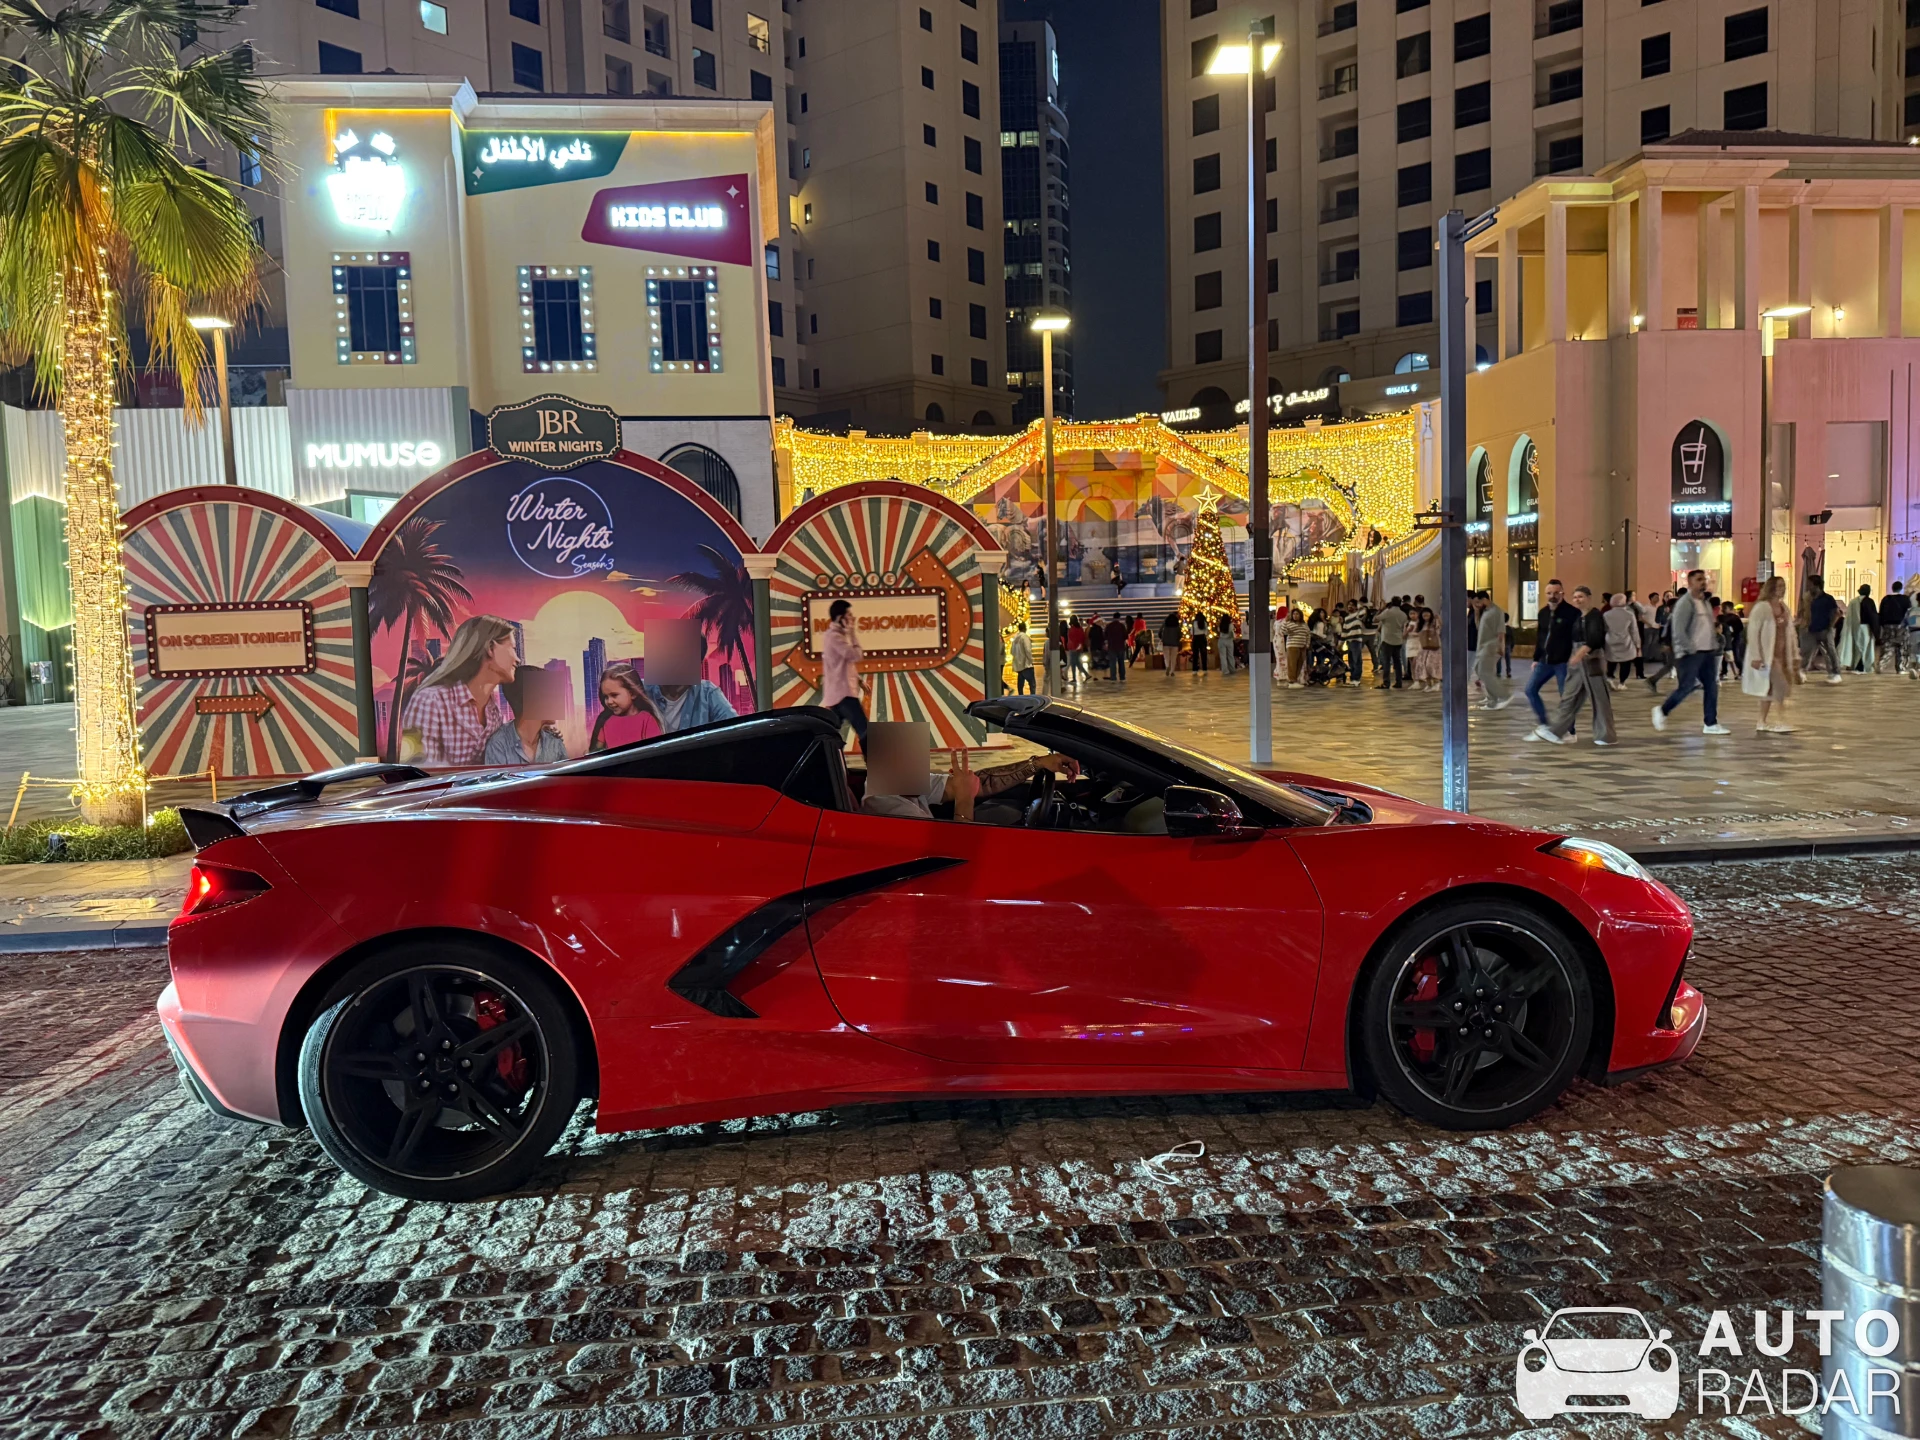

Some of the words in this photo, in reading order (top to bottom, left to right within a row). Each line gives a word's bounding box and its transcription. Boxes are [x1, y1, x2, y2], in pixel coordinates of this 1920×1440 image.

[481, 135, 546, 163] الأطفال
[549, 137, 592, 170] نادي
[611, 206, 666, 228] KIDS
[668, 206, 723, 228] CLUB
[536, 409, 583, 441] JBR
[1161, 407, 1201, 423] VAULTS
[307, 441, 441, 468] MUMUSO
[508, 441, 557, 453] WINTER
[559, 440, 603, 452] NIGHTS
[1681, 486, 1707, 495] JUICES
[506, 492, 588, 522] Winter
[527, 521, 614, 564] Nights
[571, 554, 607, 574] Season
[606, 558, 615, 570] 3
[818, 573, 894, 586] MOVIE
[857, 613, 937, 632] SHOWING
[158, 635, 182, 648] ON
[183, 632, 240, 647] SCREEN
[241, 630, 302, 645] TONIGHT
[1454, 800, 1462, 812] HE
